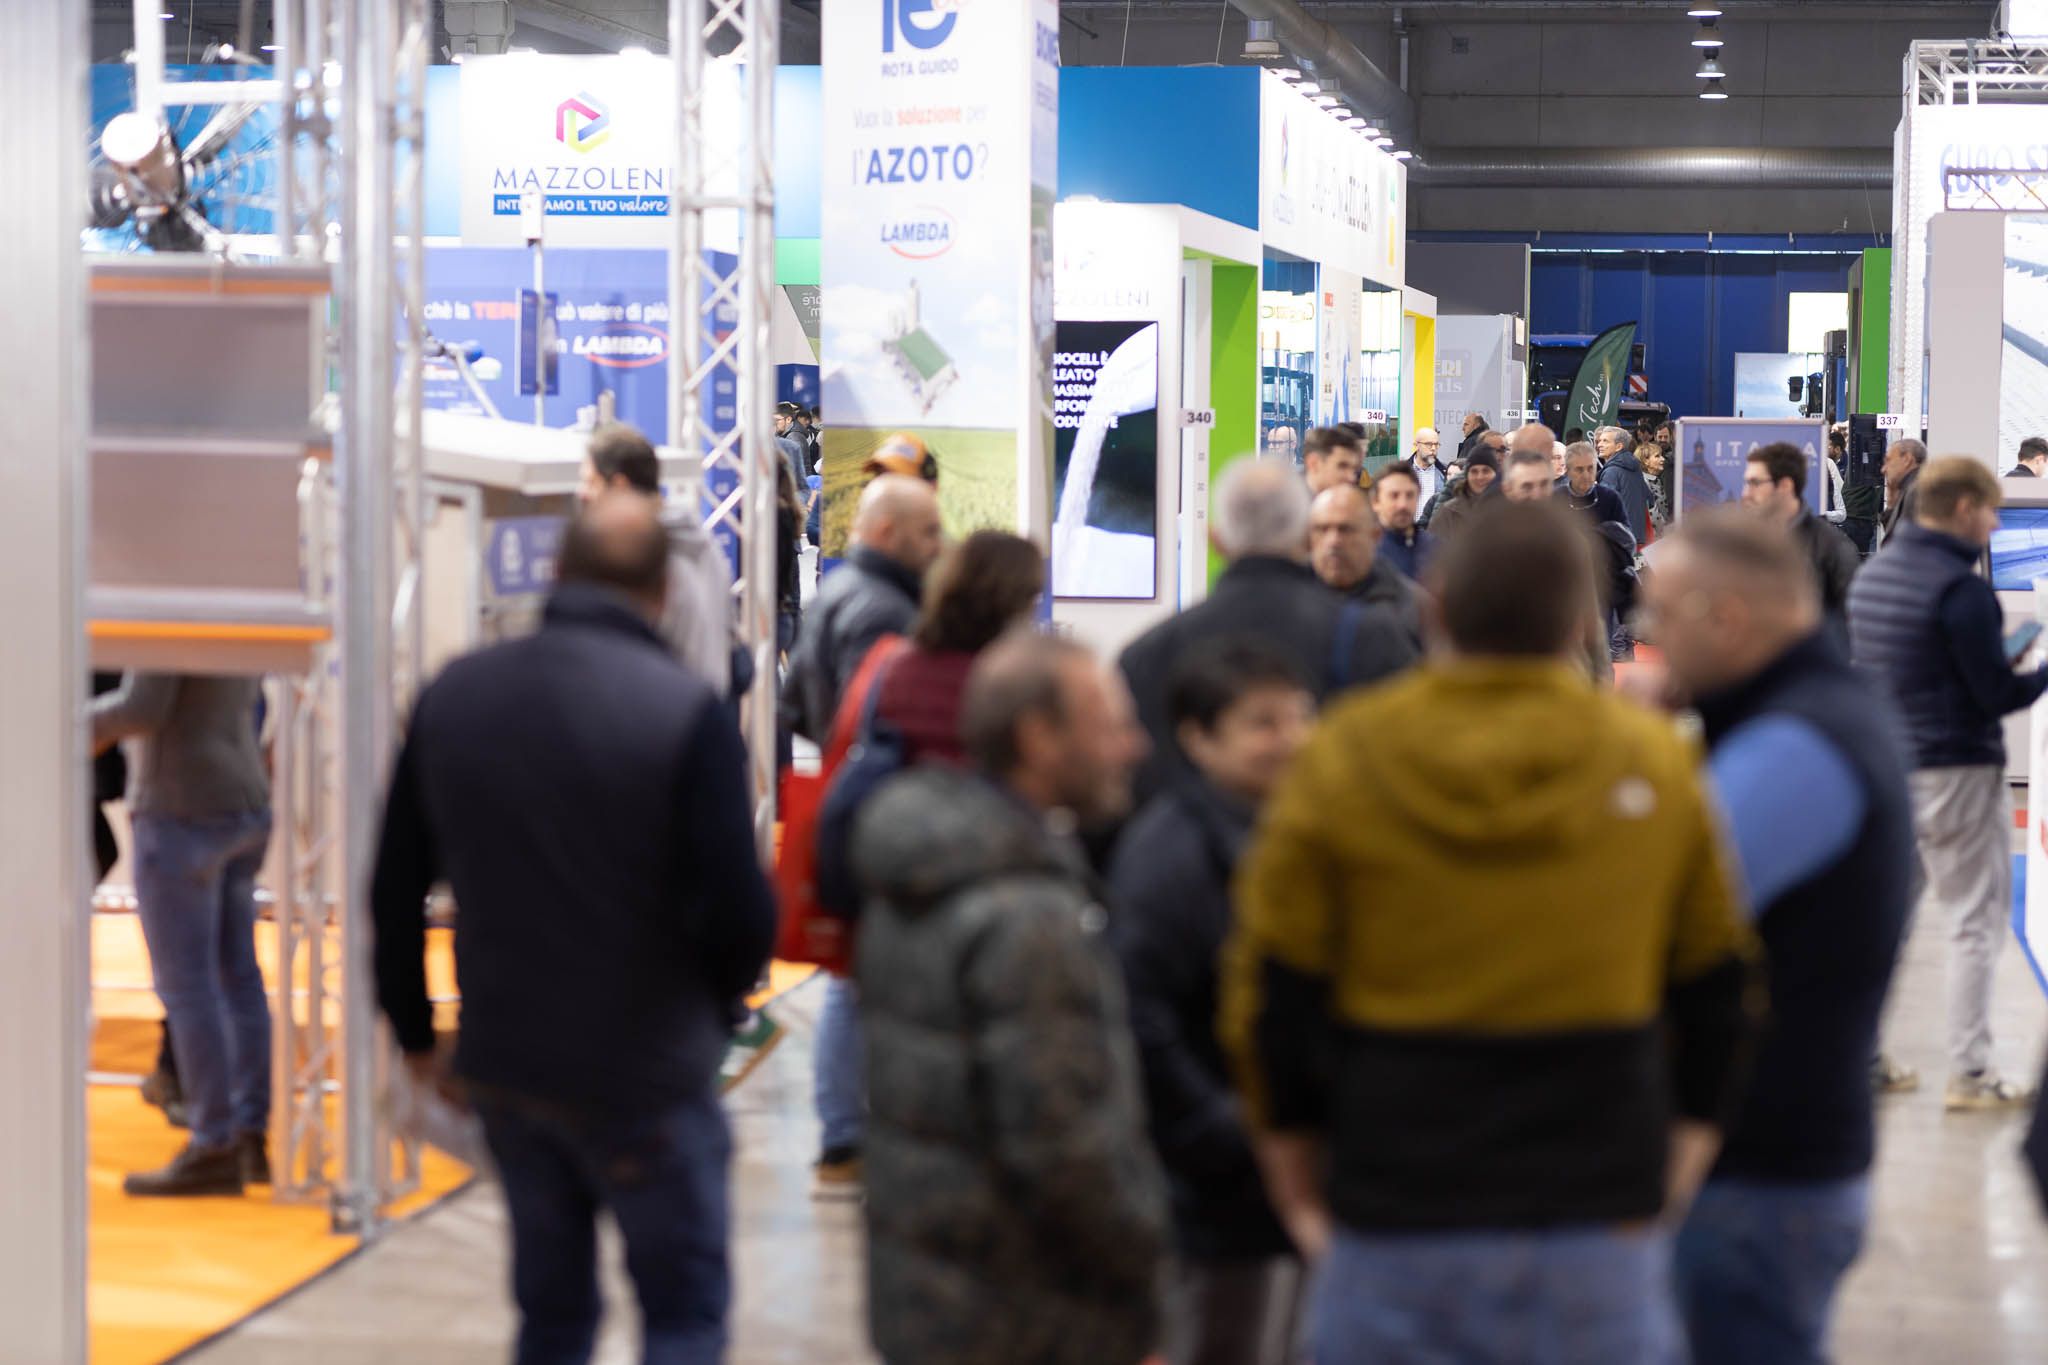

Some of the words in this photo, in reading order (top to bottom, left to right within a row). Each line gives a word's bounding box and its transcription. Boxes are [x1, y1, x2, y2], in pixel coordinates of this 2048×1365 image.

[881, 62, 914, 77] ROTA
[918, 57, 959, 75] GUIDO
[896, 104, 962, 127] soluzione
[576, 200, 587, 211] IL
[589, 200, 617, 212] TUO
[619, 196, 669, 212] valore
[880, 221, 950, 243] LAMBDA
[578, 303, 623, 321] valere
[626, 302, 642, 321] di
[573, 336, 662, 354] LAMBDA
[1580, 385, 1602, 423] Tech
[1187, 411, 1212, 424] 340
[1367, 411, 1384, 421] 340
[1880, 416, 1898, 426] 337
